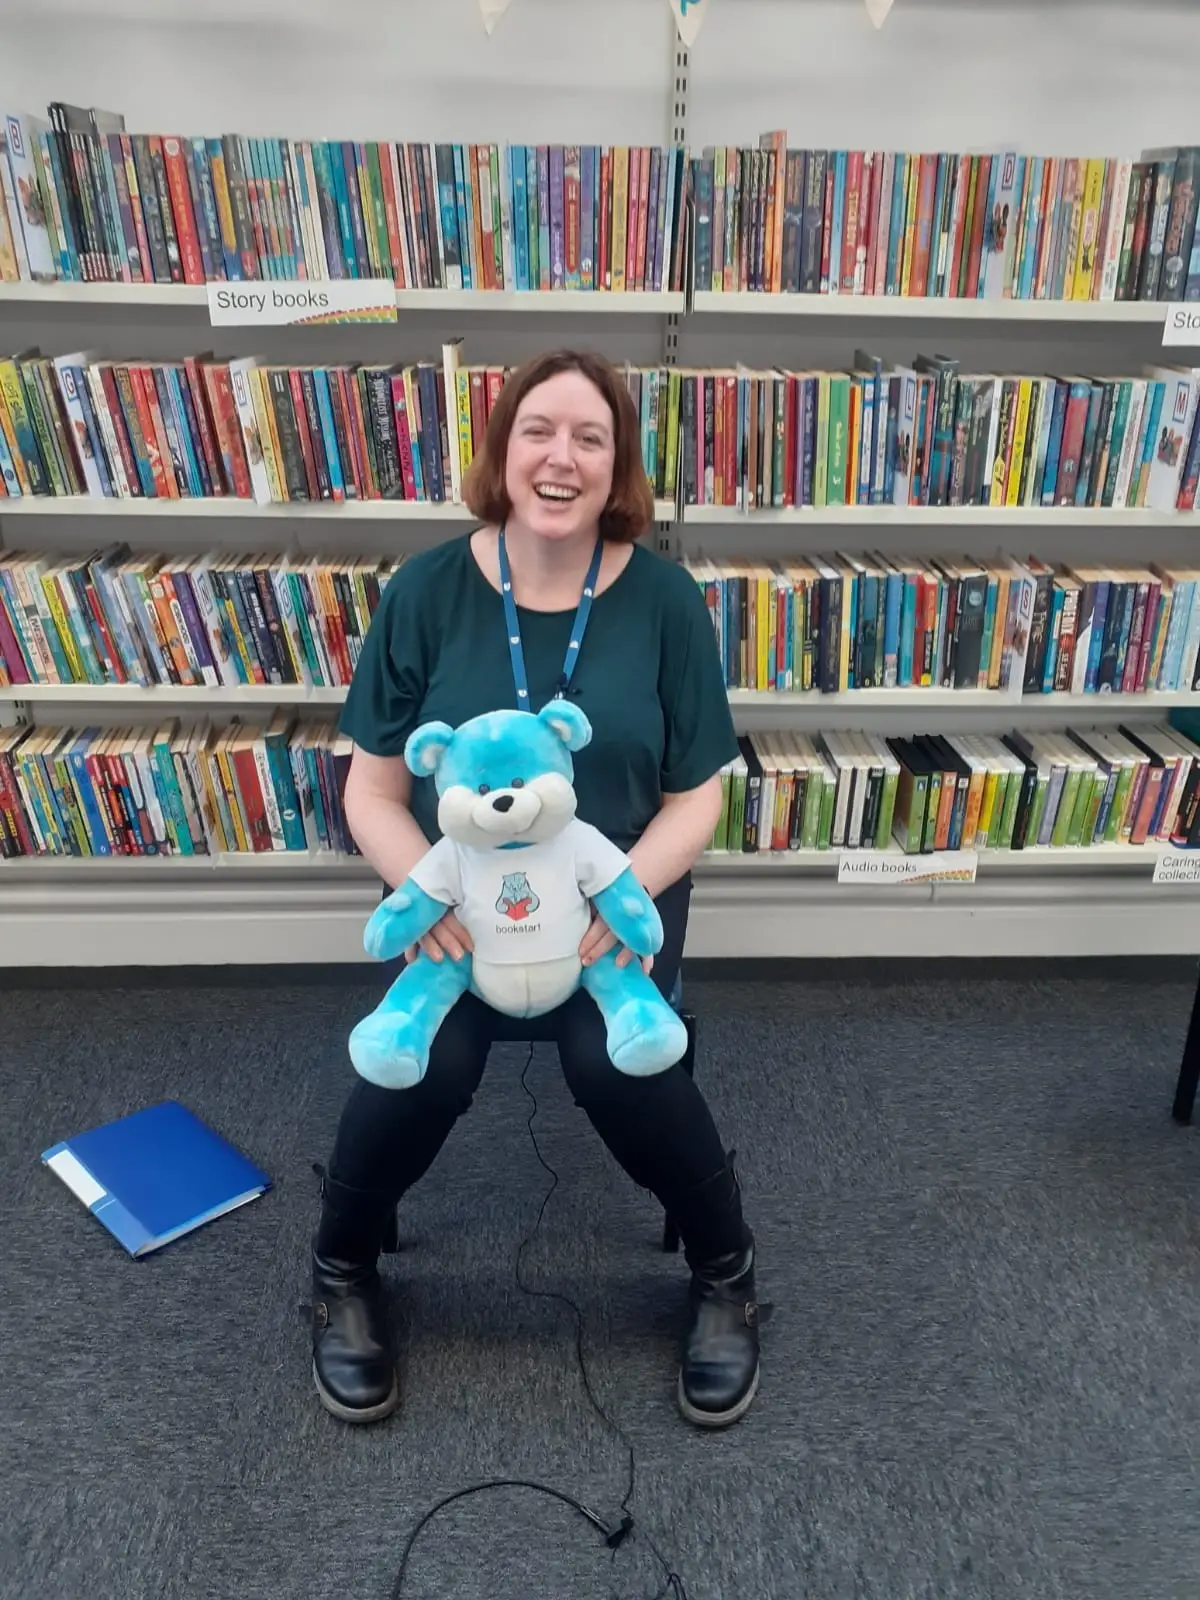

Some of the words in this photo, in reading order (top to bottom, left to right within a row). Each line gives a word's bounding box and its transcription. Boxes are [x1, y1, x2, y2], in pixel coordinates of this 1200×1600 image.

[216, 290, 266, 312] Story
[273, 289, 329, 308] books
[65, 372, 75, 395] G
[1176, 391, 1187, 414] M
[842, 860, 878, 873] Audio
[881, 861, 917, 873] books
[495, 922, 541, 935] bookstart
